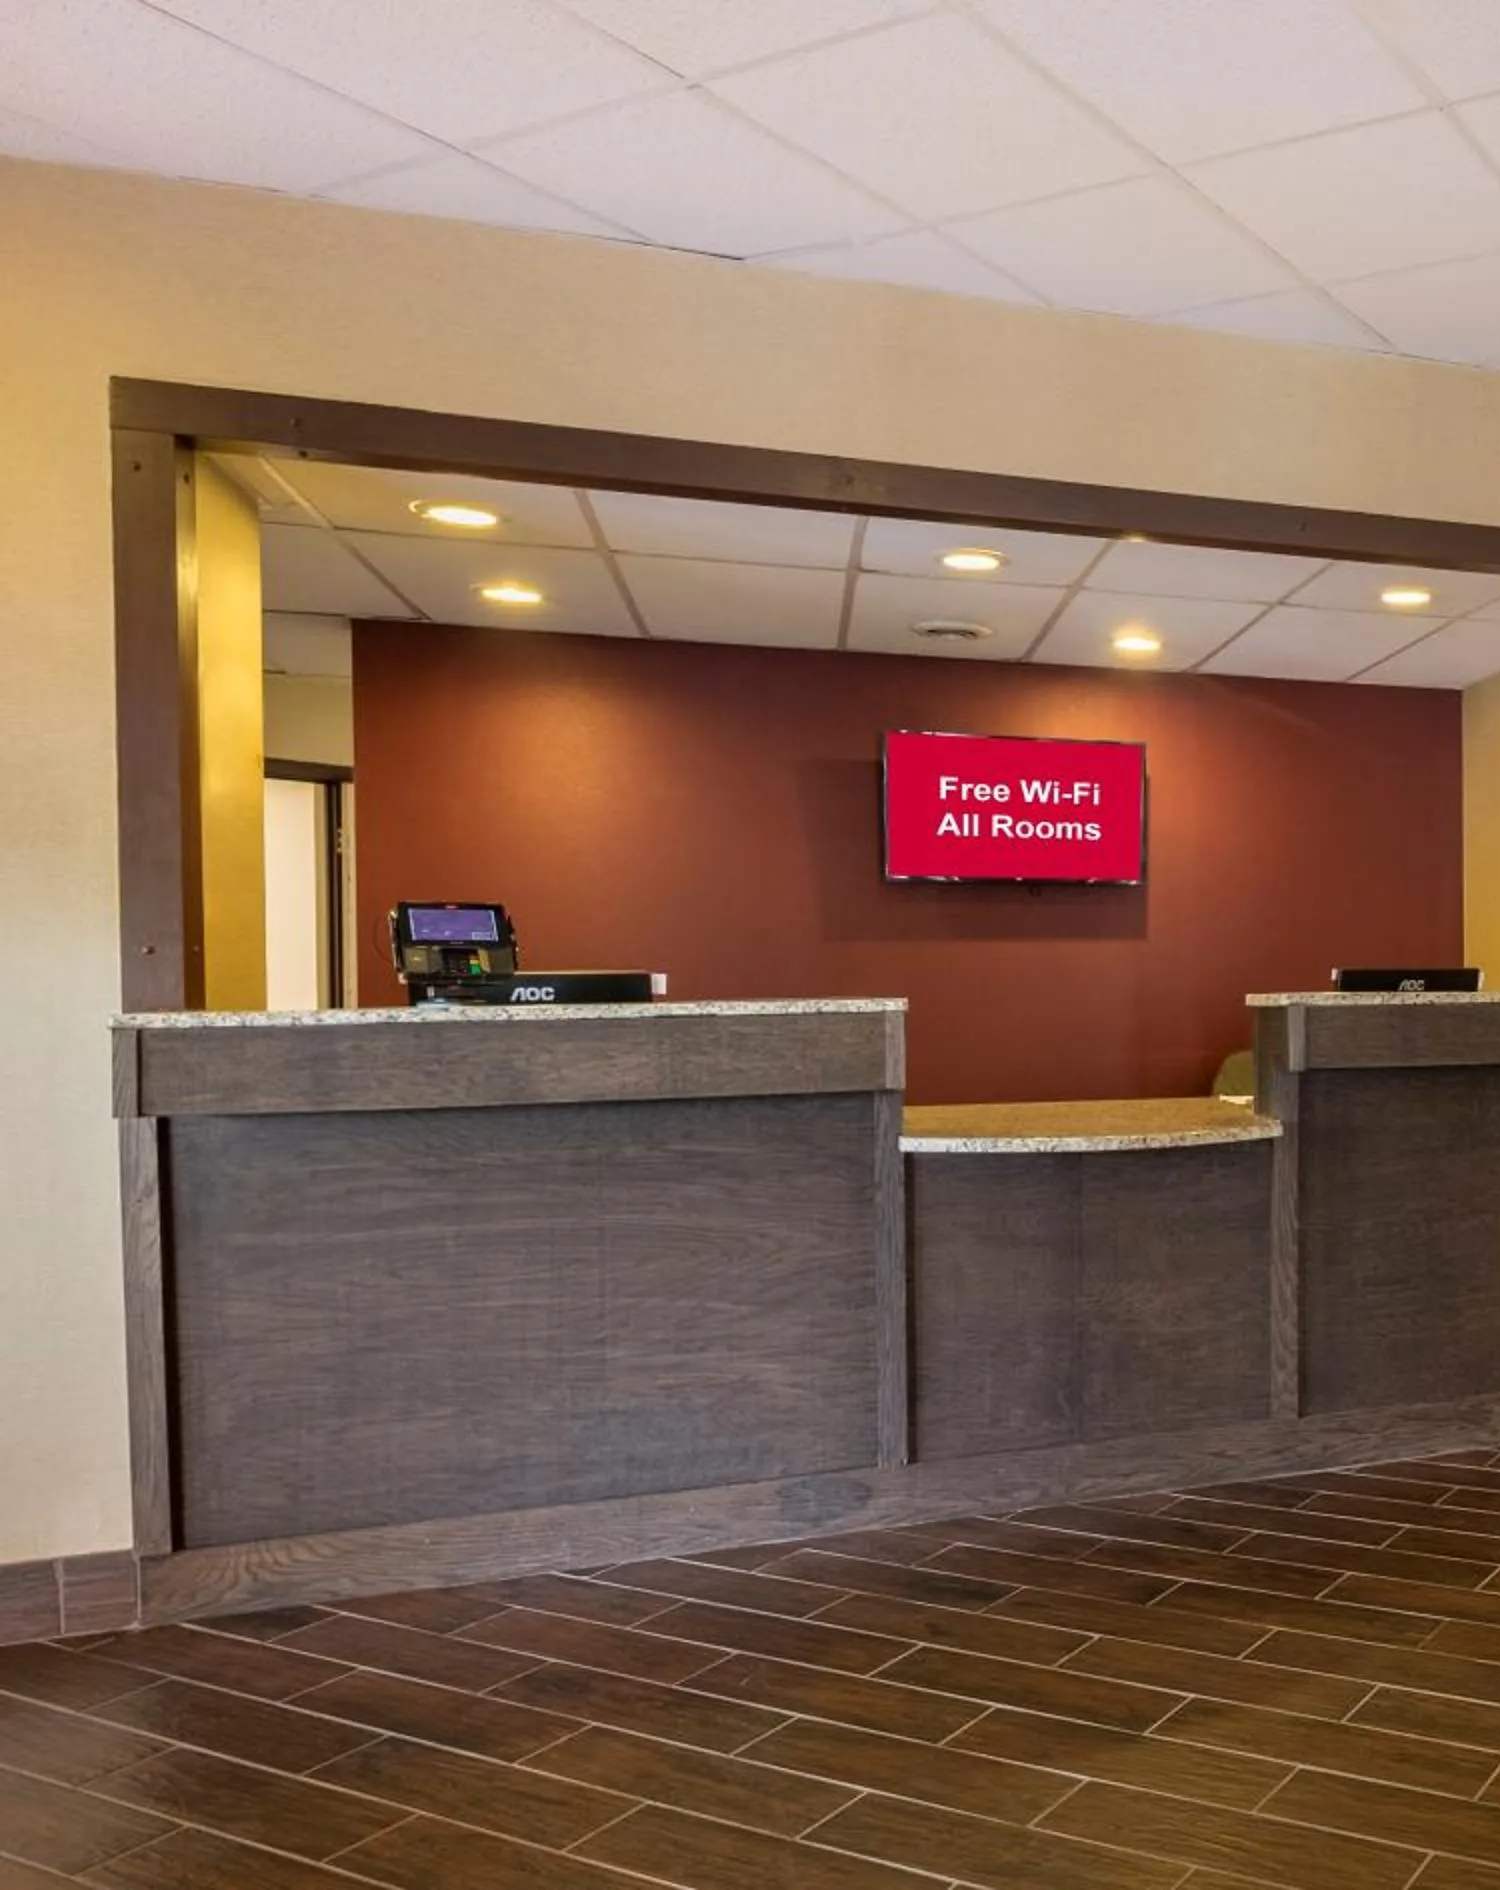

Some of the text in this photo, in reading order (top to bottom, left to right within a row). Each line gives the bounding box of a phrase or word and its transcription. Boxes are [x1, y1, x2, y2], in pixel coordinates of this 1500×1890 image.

[938, 775, 1101, 806] Free Wi-Fi
[935, 812, 1102, 841] All Rooms
[510, 986, 555, 1002] AOC
[1399, 979, 1425, 991] AOC
